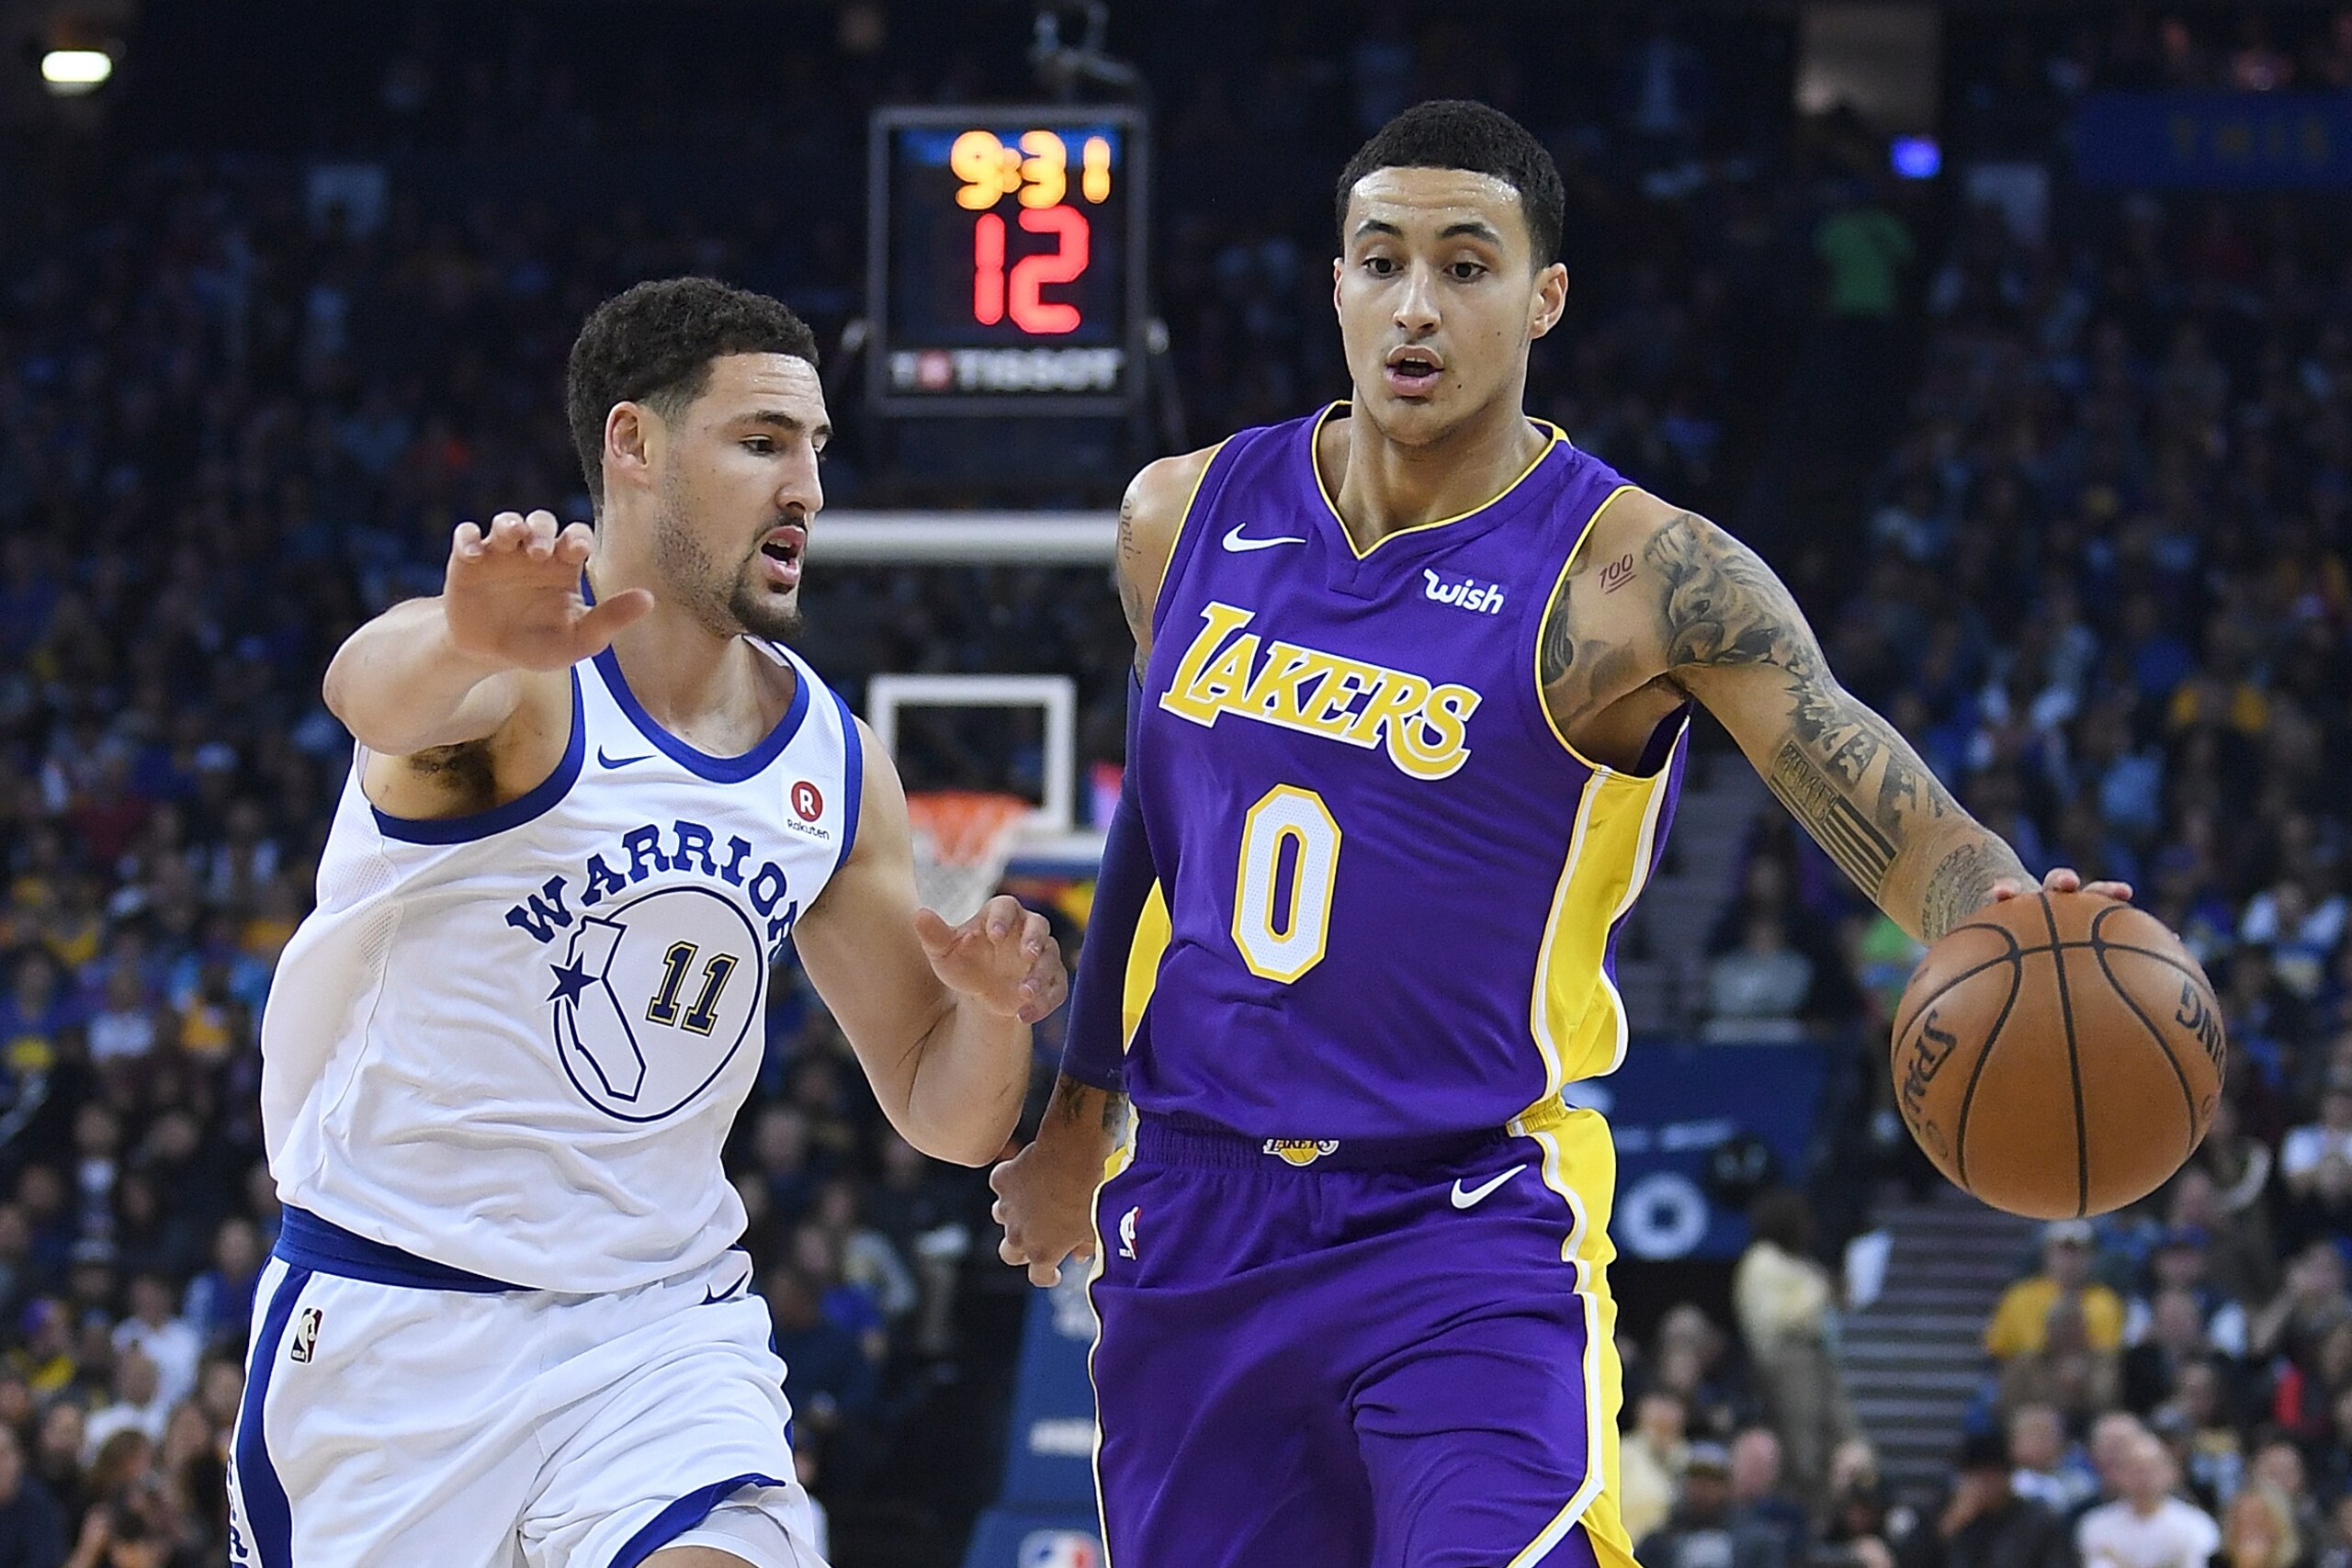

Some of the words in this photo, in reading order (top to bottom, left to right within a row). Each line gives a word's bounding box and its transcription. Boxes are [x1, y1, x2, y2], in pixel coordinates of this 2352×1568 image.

[951, 130, 1110, 209] 9:31
[974, 204, 1090, 333] 12
[1599, 553, 1634, 589] 100
[1159, 600, 1483, 781] LAKERS
[787, 818, 830, 840] Rakuten
[1231, 783, 1342, 985] 0
[645, 940, 740, 1038] 11
